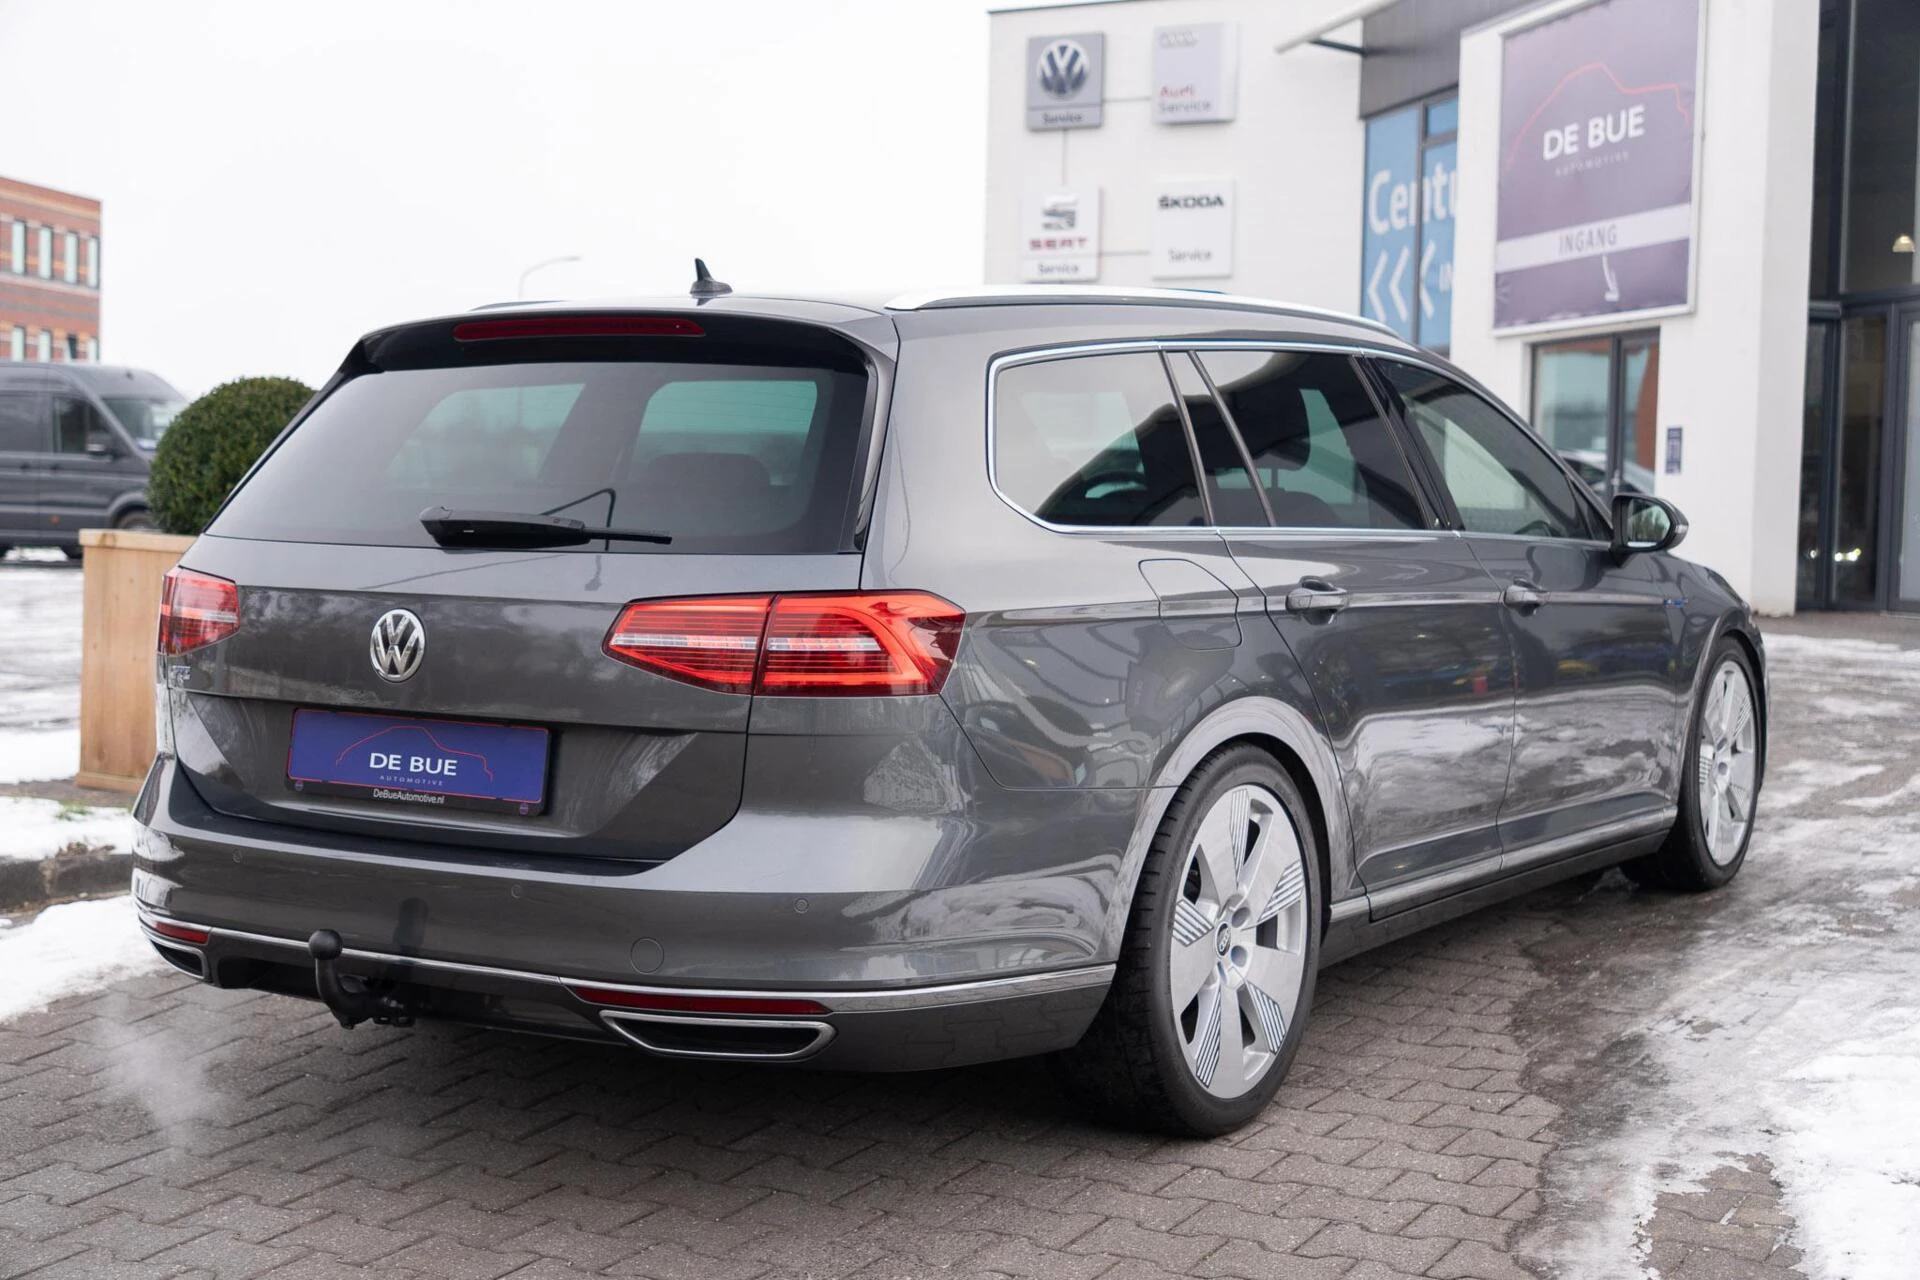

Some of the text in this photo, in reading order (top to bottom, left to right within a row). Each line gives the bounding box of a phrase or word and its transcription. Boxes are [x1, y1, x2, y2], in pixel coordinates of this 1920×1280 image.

[1543, 104, 1646, 160] DE BUE
[1029, 237, 1087, 251] SEAT
[1558, 224, 1618, 256] INGANG
[1168, 249, 1213, 263] Service
[1037, 261, 1080, 275] Service
[369, 752, 458, 776] DE BUE
[380, 775, 443, 786] AUTOMOTIVE
[373, 788, 446, 804] DeBueAutomotive.nl
